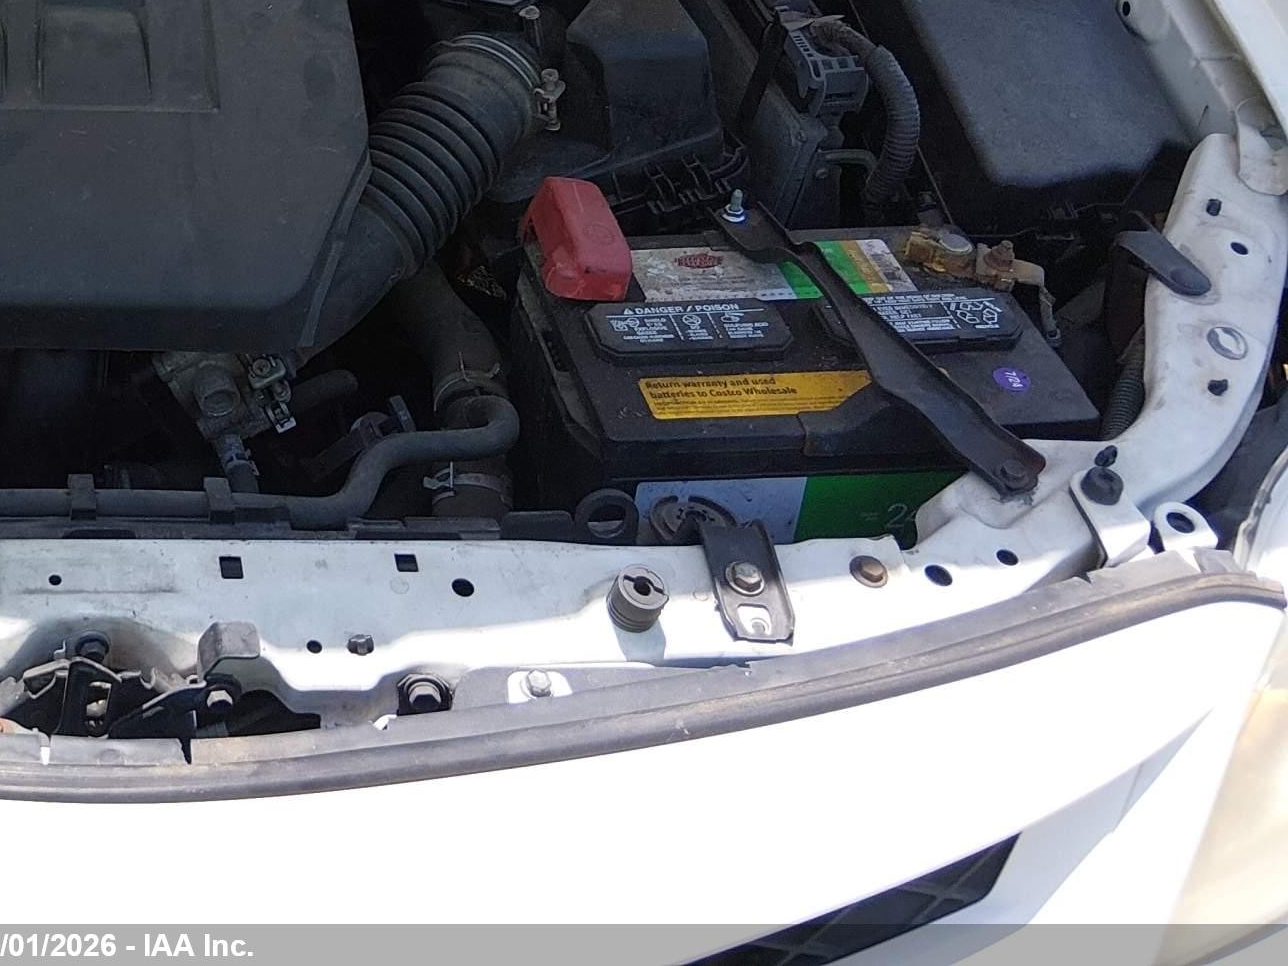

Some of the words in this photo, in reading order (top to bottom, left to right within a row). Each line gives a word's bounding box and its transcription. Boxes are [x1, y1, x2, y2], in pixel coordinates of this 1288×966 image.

[634, 306, 684, 315] DANGER
[695, 303, 740, 312] POISON
[645, 380, 682, 389] Return
[682, 380, 728, 390] warranty
[729, 379, 750, 387] and
[751, 377, 776, 386] used
[649, 390, 696, 400] batteries
[696, 390, 708, 398] to
[709, 388, 742, 397] Costco
[743, 386, 798, 396] Wholesale
